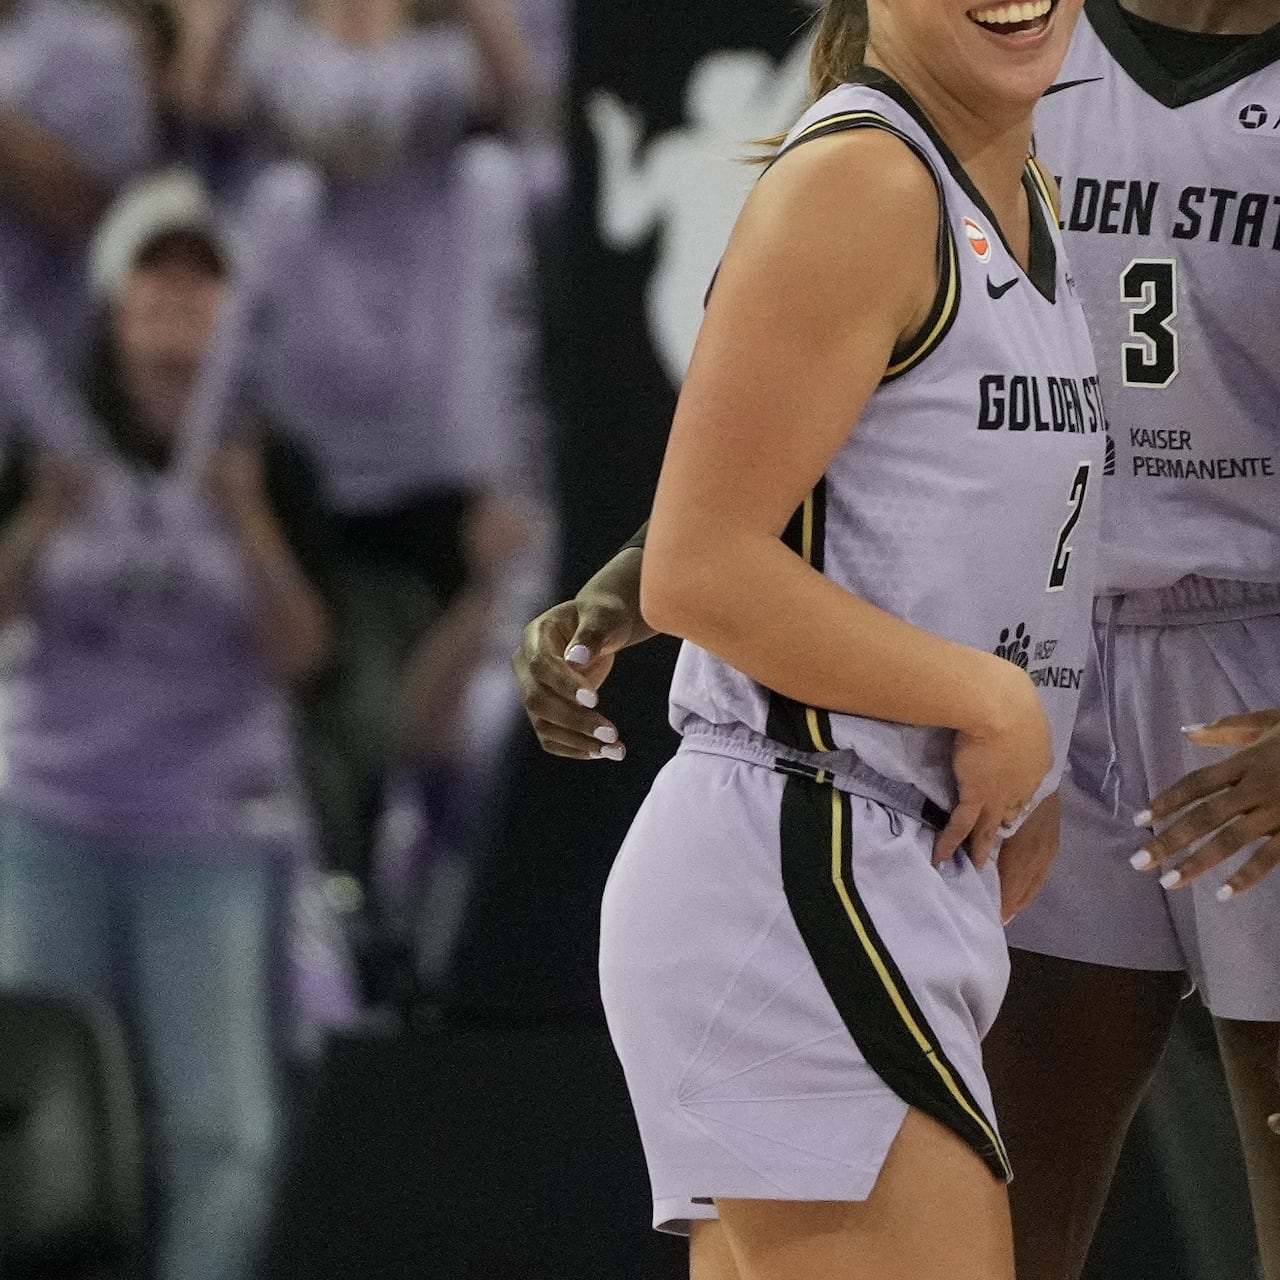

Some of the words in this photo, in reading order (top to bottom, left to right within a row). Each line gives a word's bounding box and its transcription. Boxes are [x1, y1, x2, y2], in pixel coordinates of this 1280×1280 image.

[1119, 257, 1180, 389] 3
[977, 374, 1085, 435] GOLDEN
[1130, 427, 1192, 451] KAISER
[1132, 455, 1275, 480] PERMANENTE
[1046, 461, 1092, 593] 2
